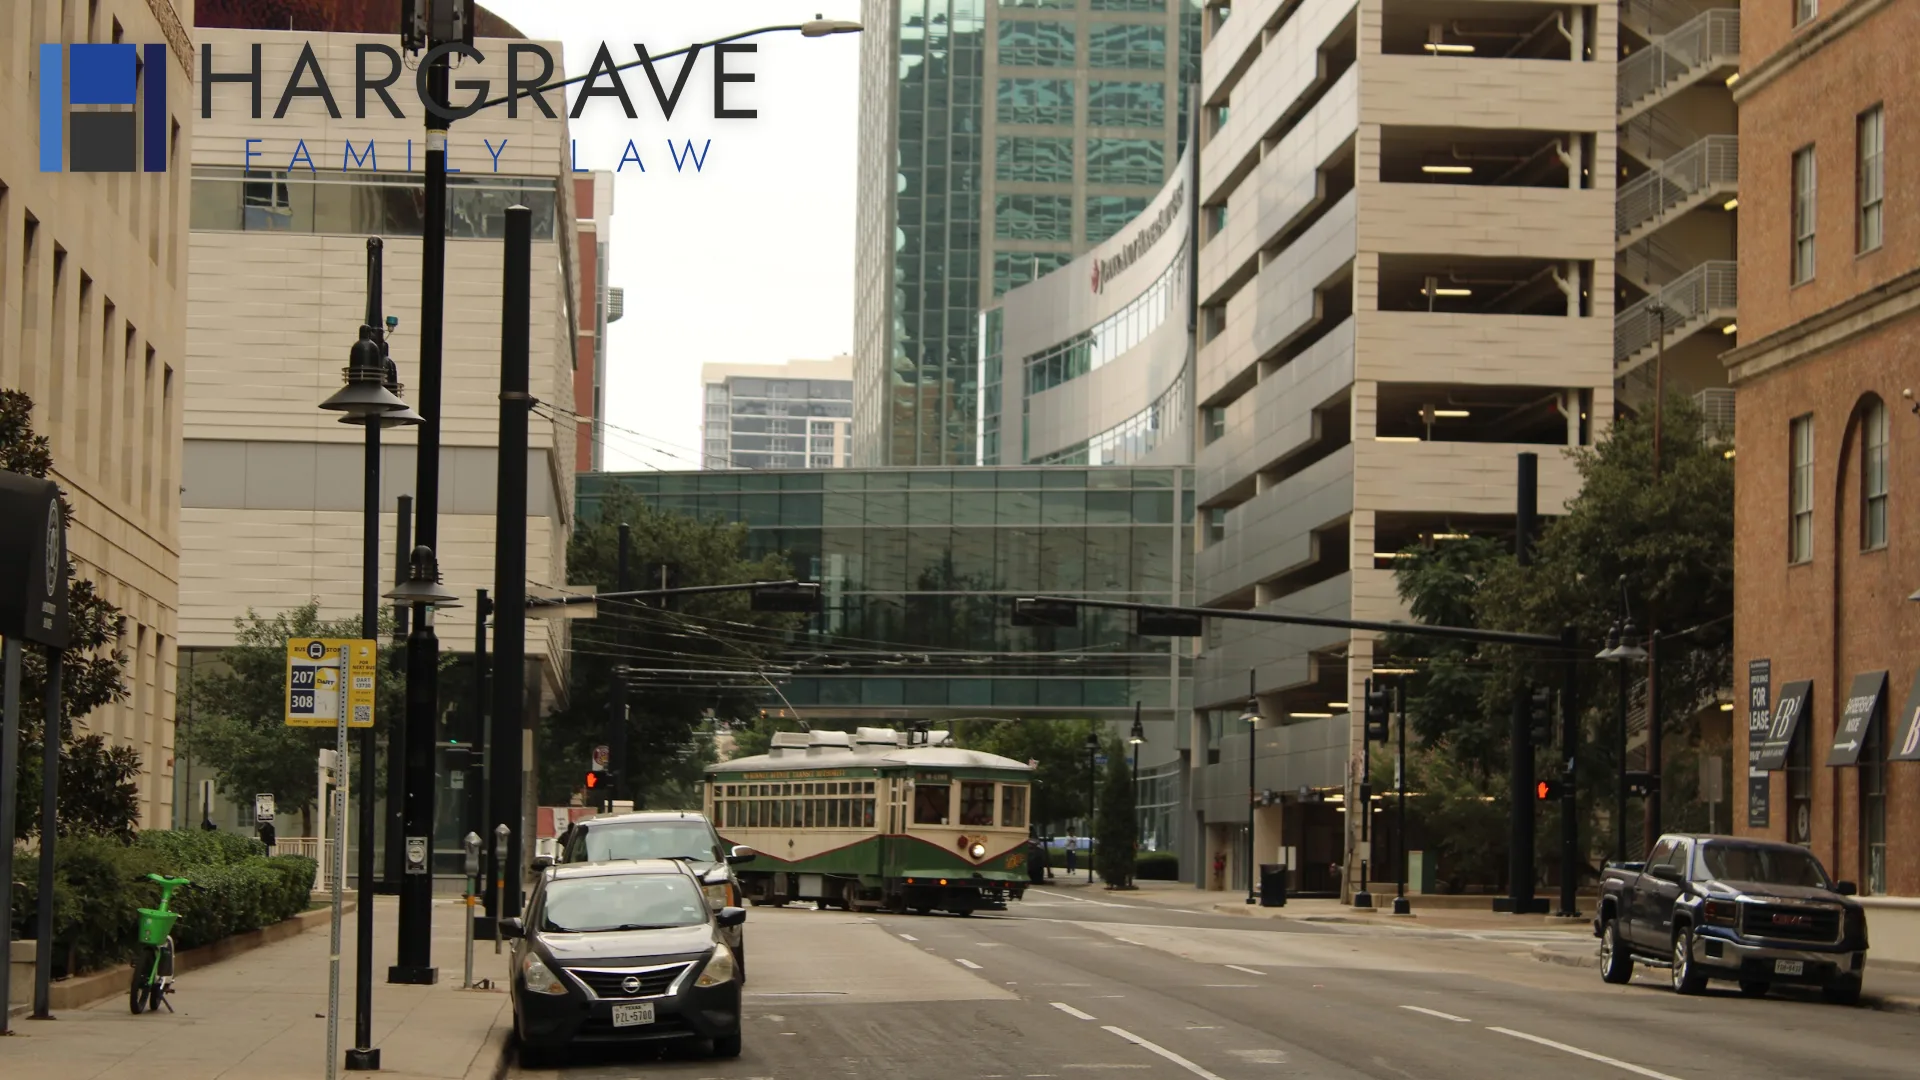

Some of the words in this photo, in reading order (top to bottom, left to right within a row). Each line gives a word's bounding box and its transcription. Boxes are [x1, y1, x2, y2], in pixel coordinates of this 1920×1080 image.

[292, 671, 314, 684] 207
[317, 678, 335, 686] DART
[291, 695, 314, 708] 308
[1752, 687, 1766, 707] FOR
[1749, 710, 1770, 731] LEASE
[1772, 913, 1812, 926] GMC
